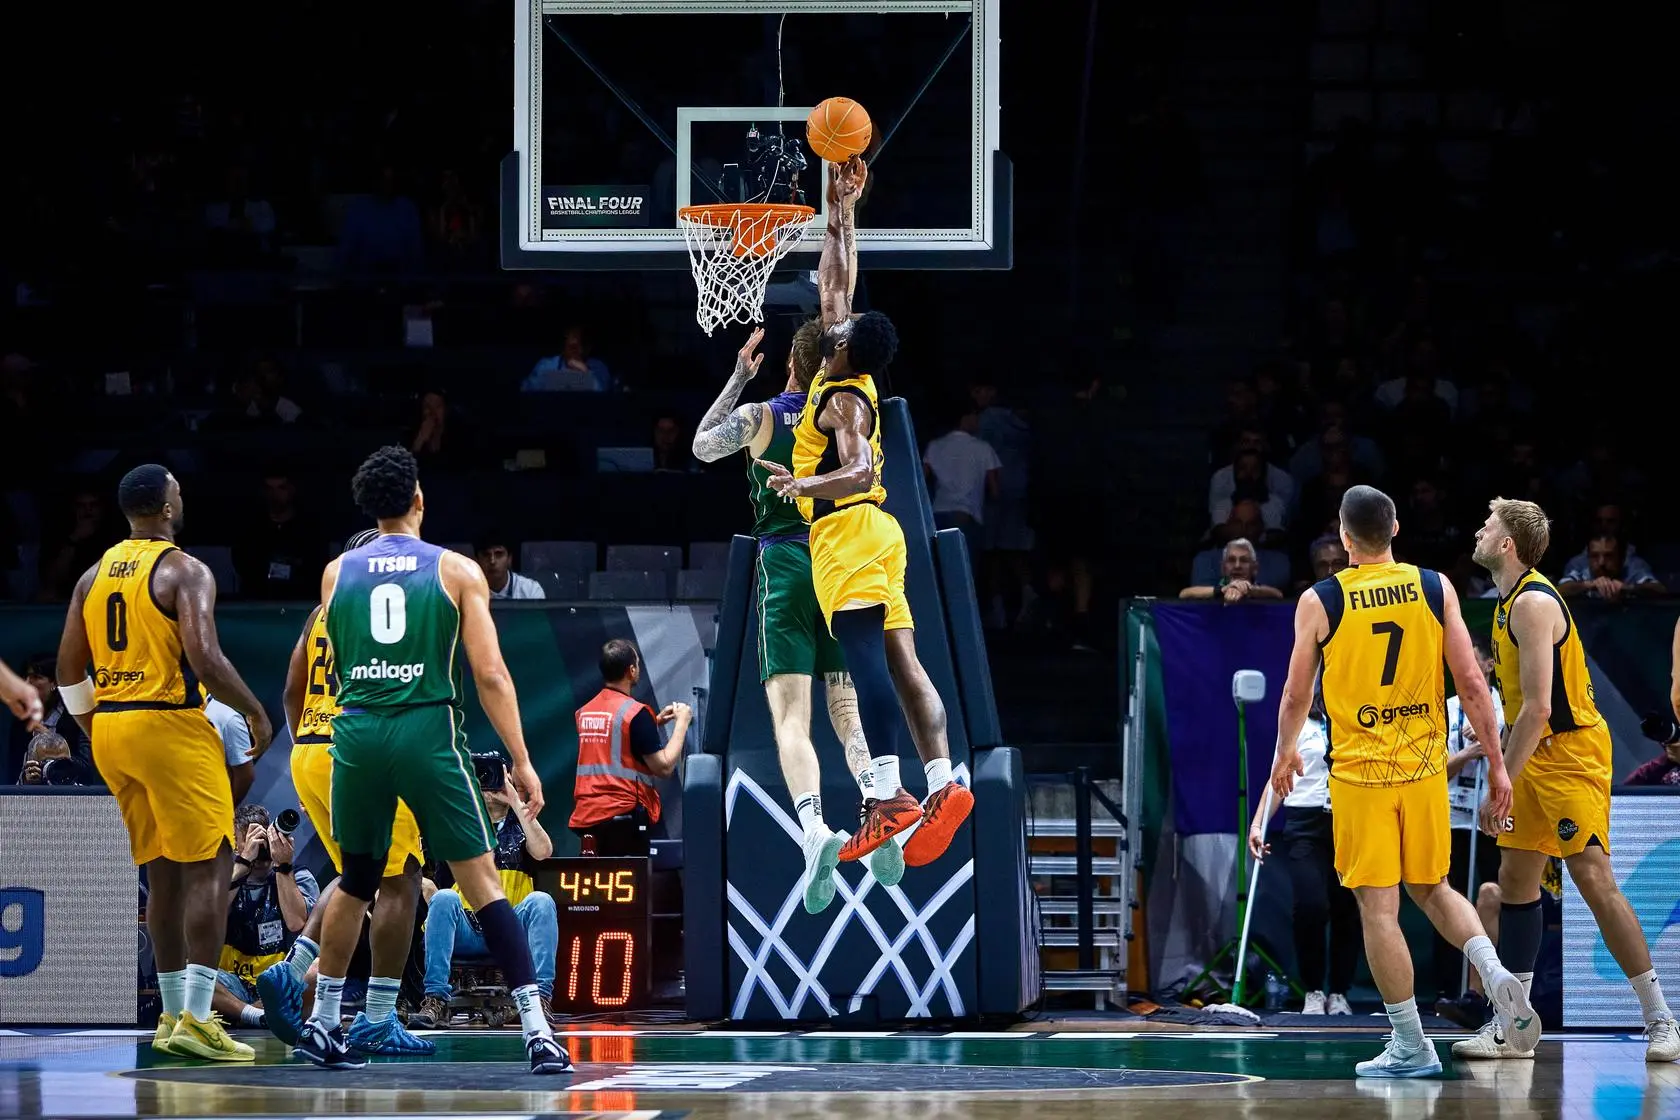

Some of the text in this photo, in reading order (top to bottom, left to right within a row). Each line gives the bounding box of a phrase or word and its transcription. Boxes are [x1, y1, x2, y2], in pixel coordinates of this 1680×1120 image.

[547, 196, 643, 210] FINAL FOUR
[108, 560, 140, 578] GRAY
[367, 556, 417, 573] TYSON
[1349, 582, 1419, 611] FLIONIS
[107, 591, 129, 652] 0
[370, 583, 407, 645] 0
[309, 636, 338, 697] 24
[1371, 620, 1405, 687] 7
[111, 670, 145, 687] green
[1381, 702, 1430, 725] green
[559, 870, 634, 903] 4:45
[567, 931, 635, 1006] 10
